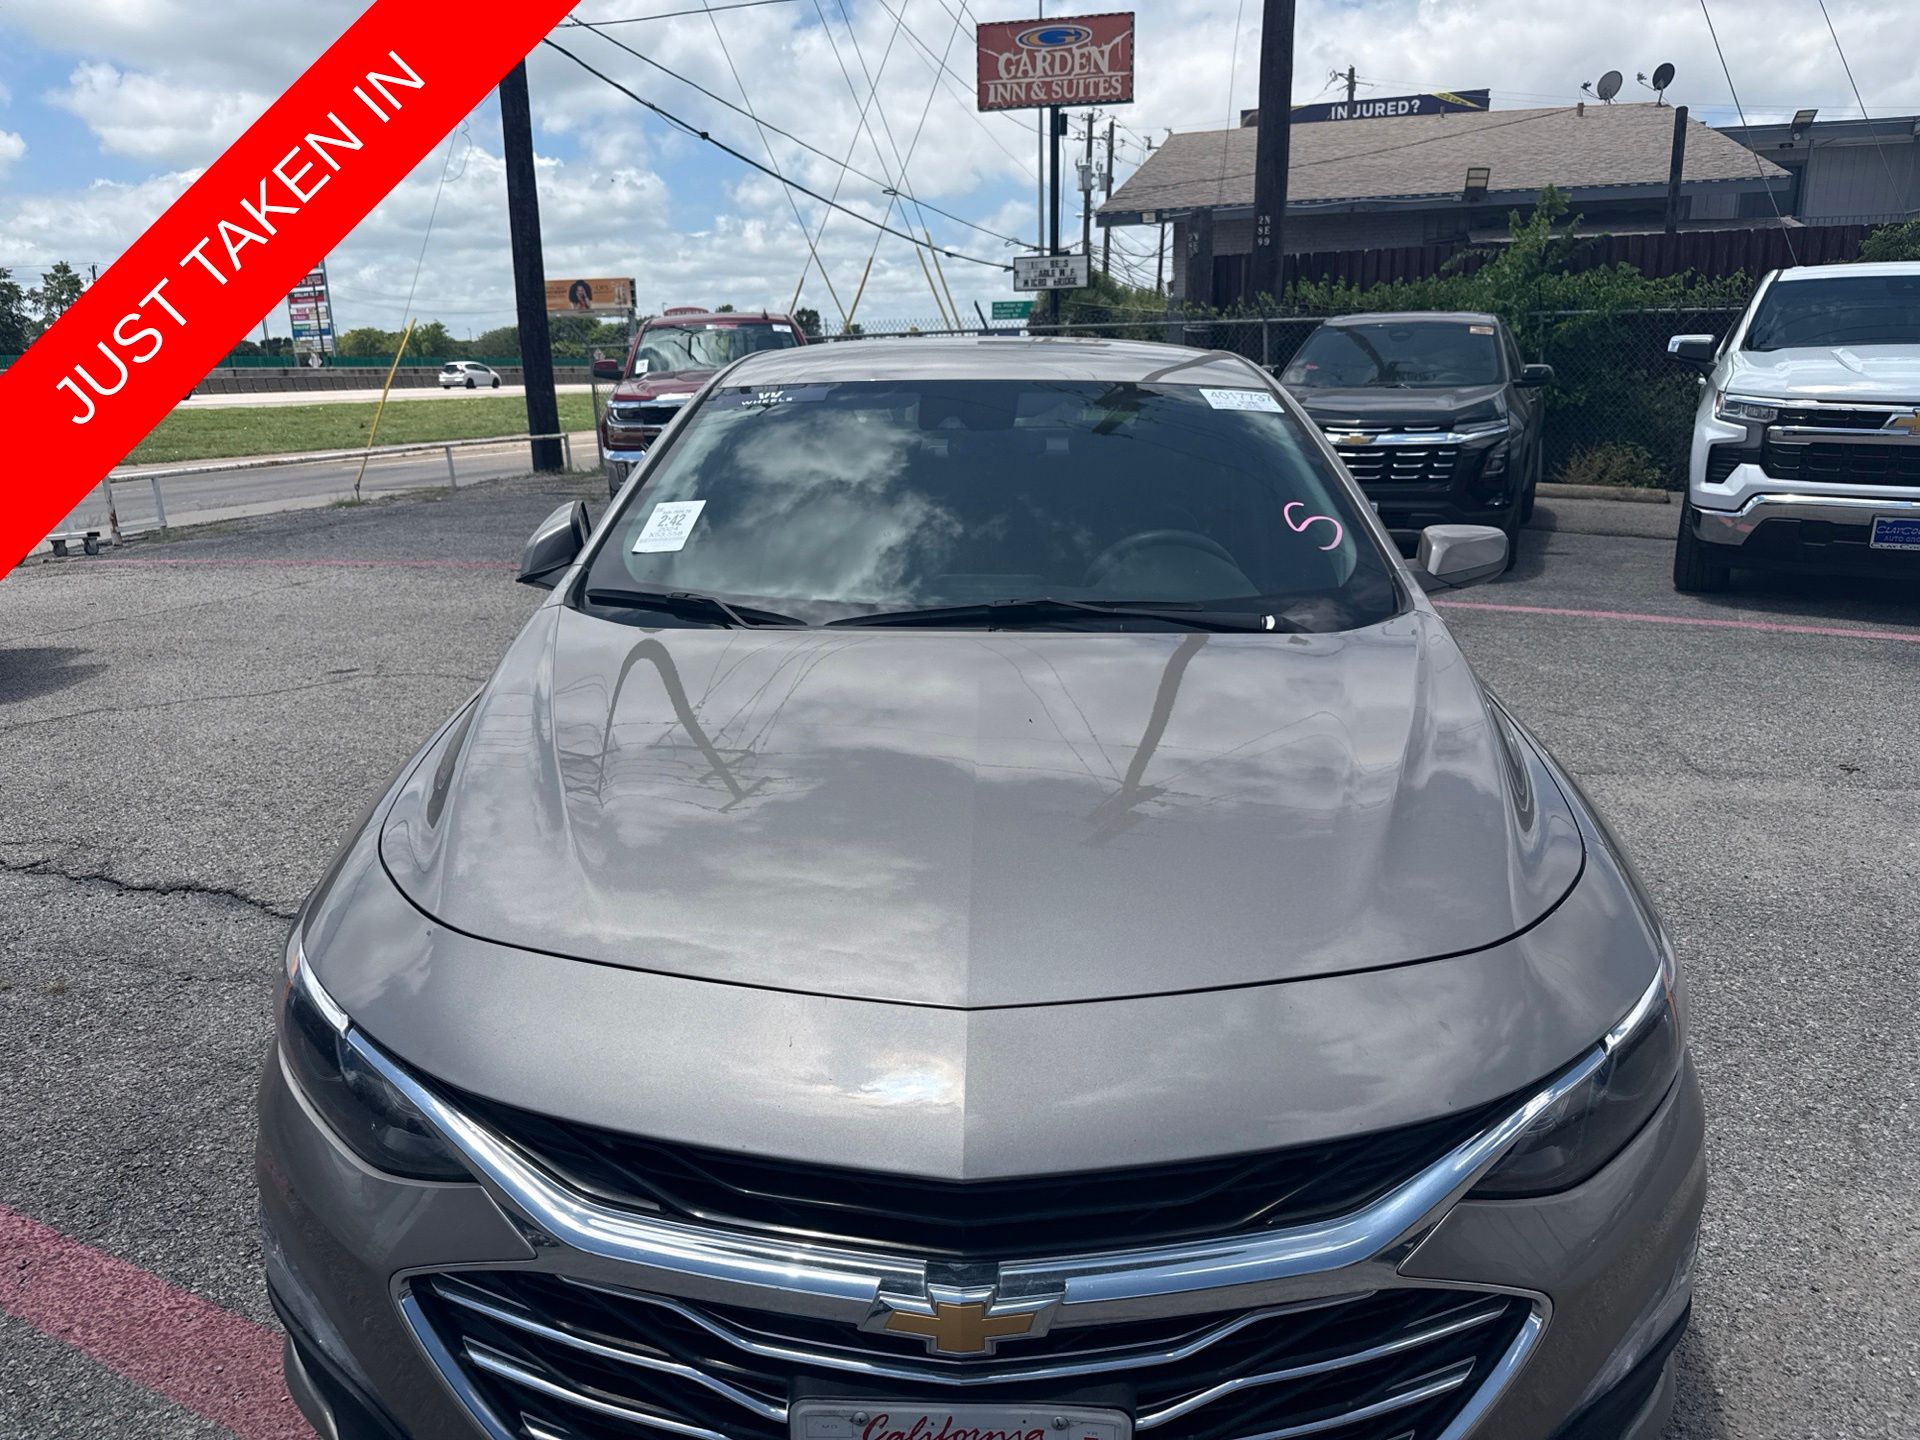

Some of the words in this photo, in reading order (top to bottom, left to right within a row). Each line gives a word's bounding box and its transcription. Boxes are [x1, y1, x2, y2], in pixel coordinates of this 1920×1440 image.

[997, 47, 1111, 81] GARDEN
[987, 82, 1026, 103] INN
[1030, 80, 1047, 101] &
[1051, 77, 1122, 99] SUITES
[657, 513, 687, 528] 2:42
